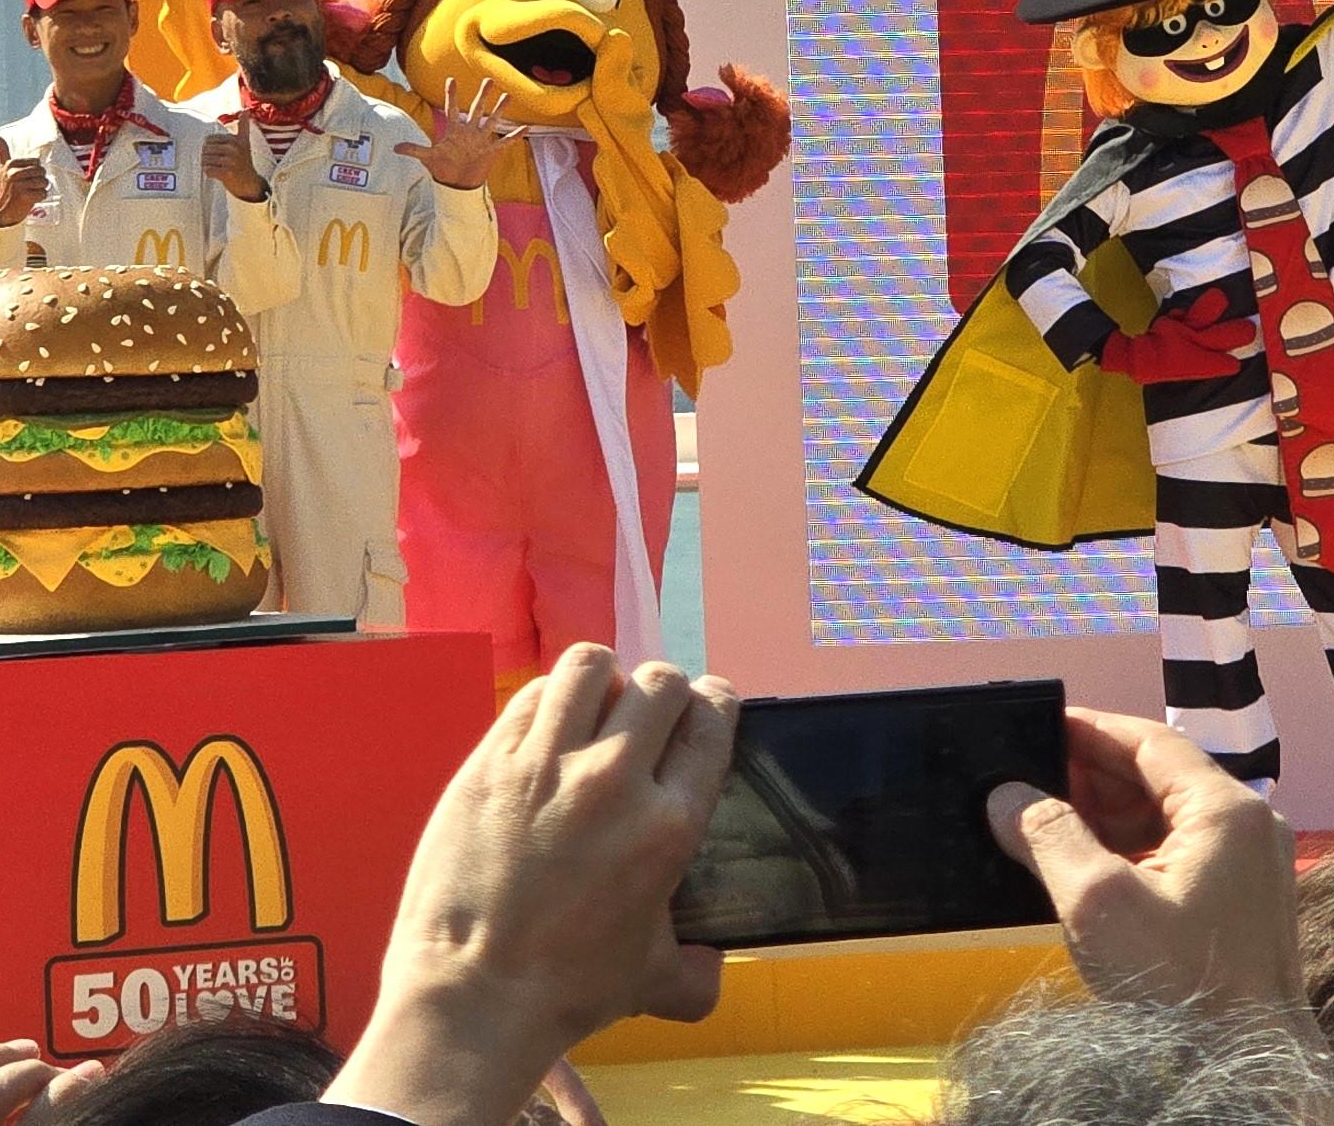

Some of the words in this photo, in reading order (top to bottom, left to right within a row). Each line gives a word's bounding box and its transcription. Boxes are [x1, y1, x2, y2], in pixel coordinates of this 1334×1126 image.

[172, 957, 279, 990] YEARS
[280, 956, 294, 981] OF
[71, 968, 170, 1039] 50
